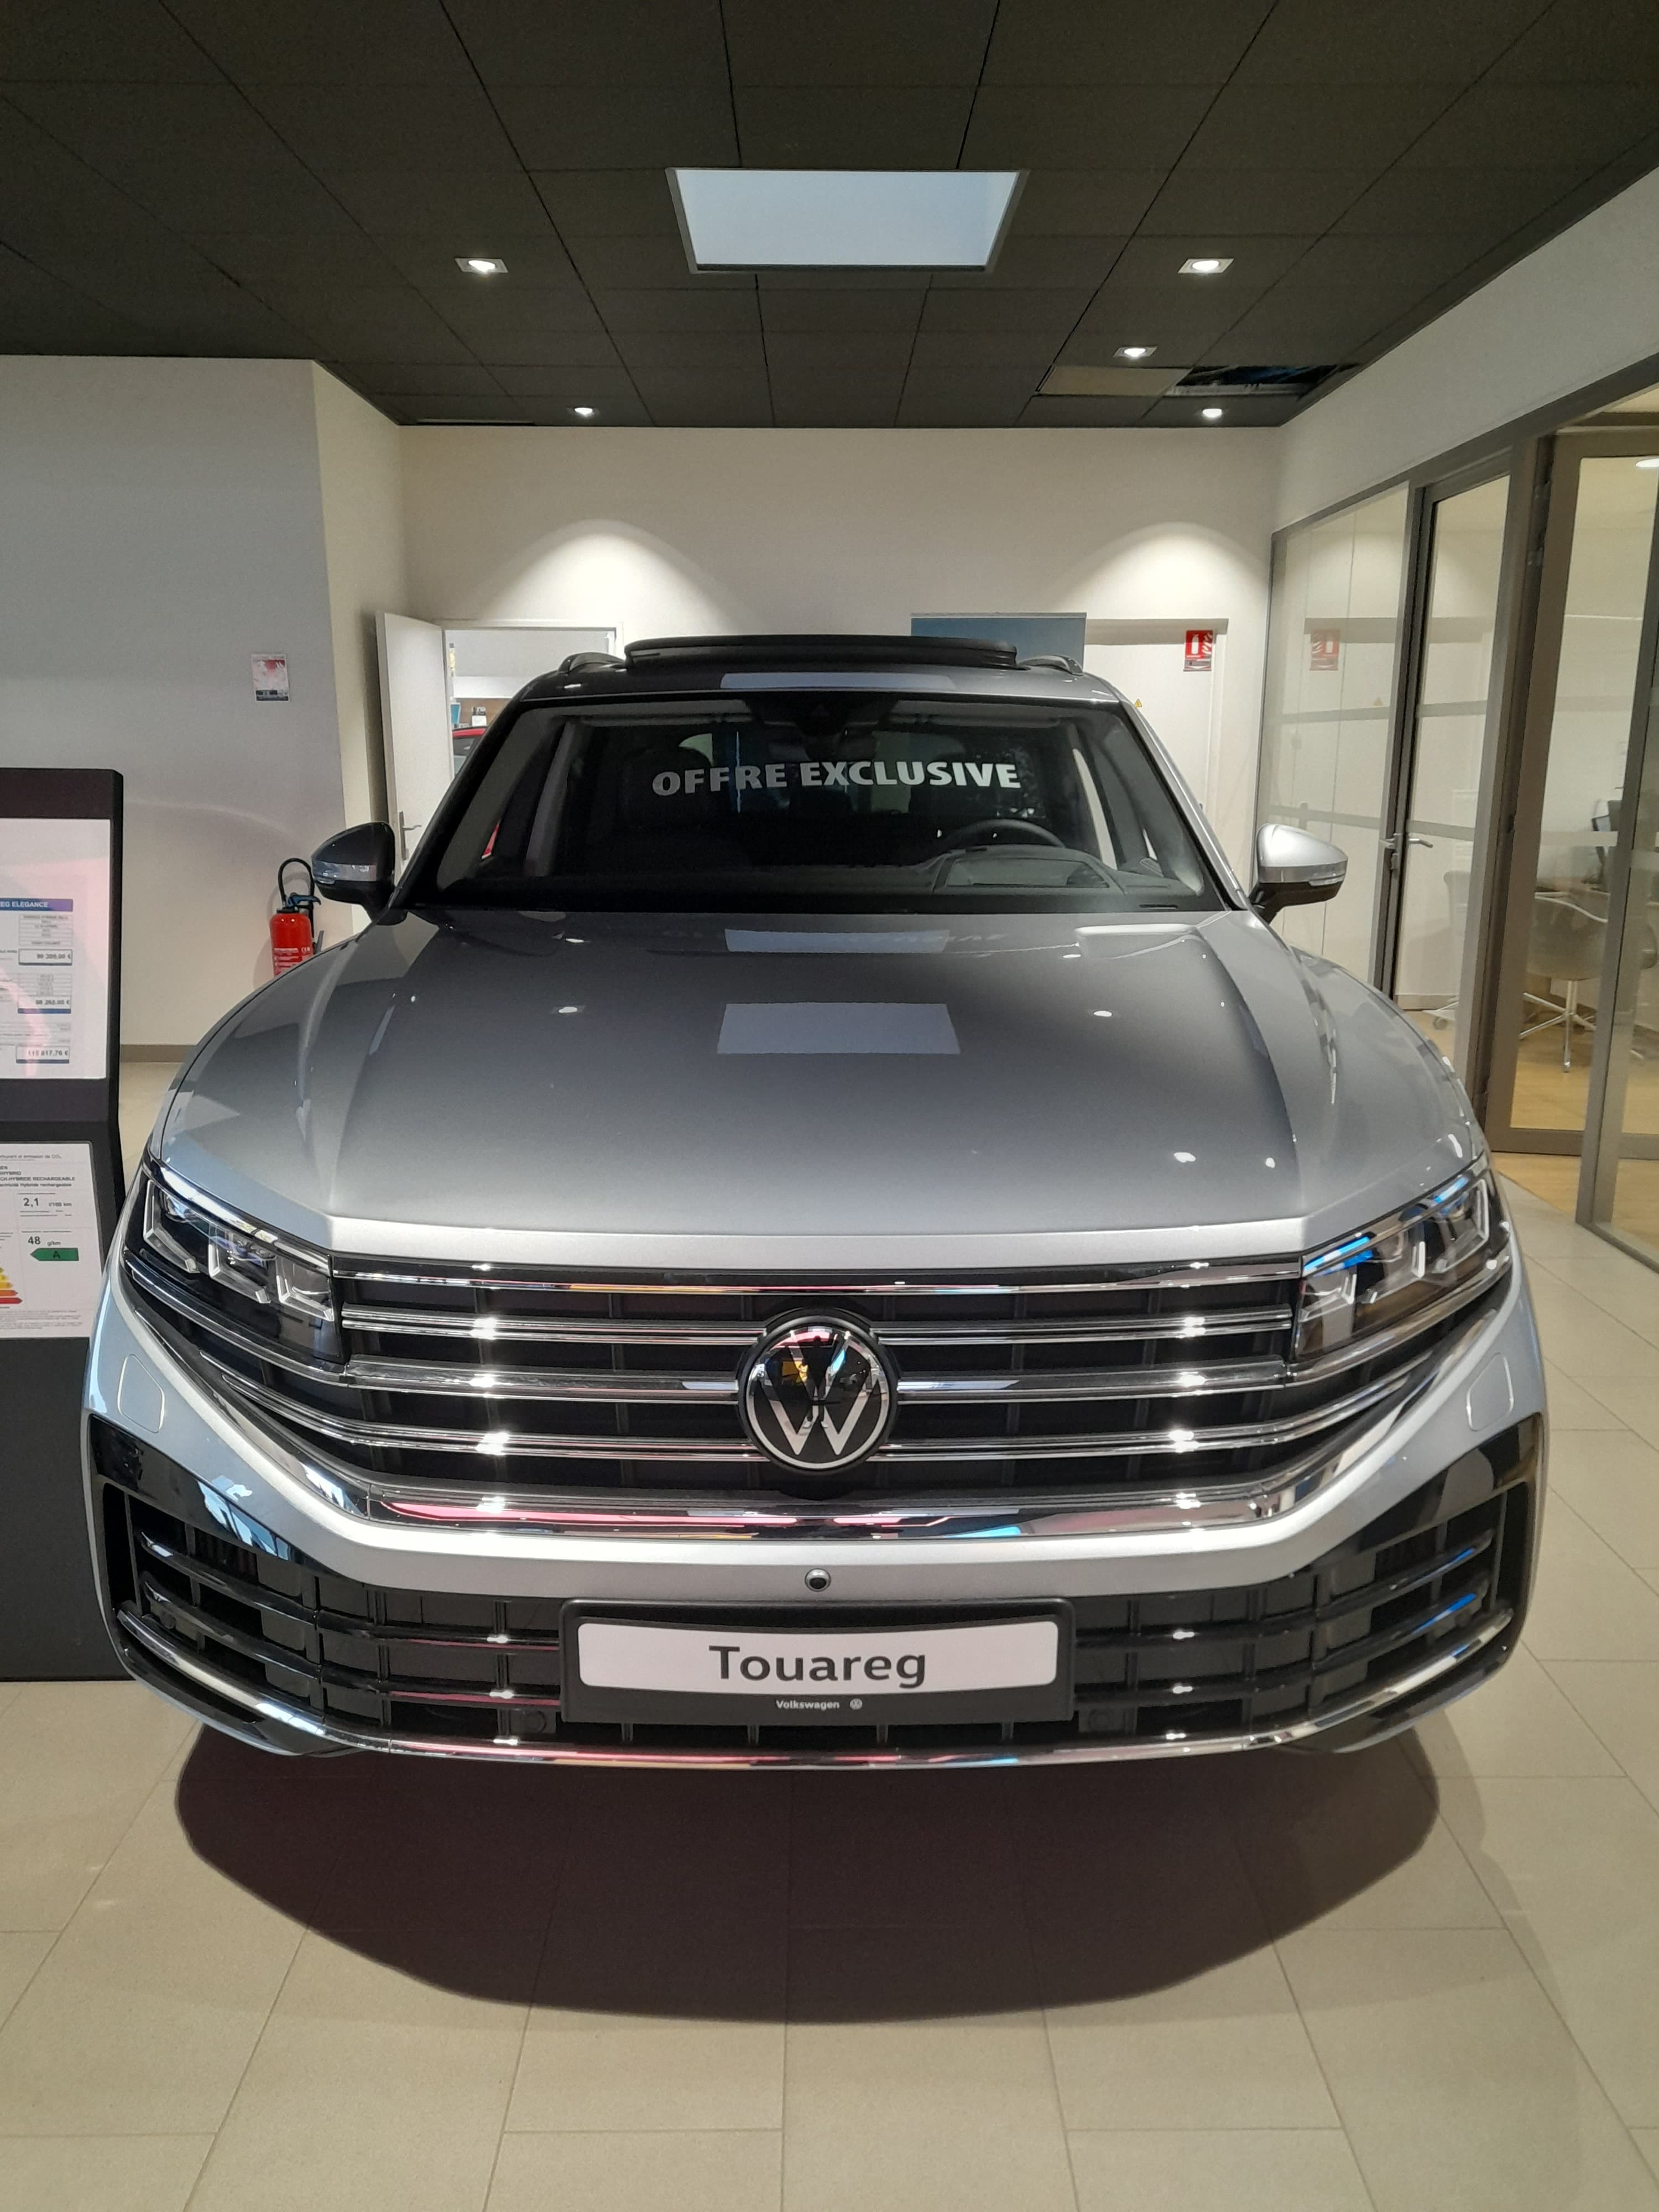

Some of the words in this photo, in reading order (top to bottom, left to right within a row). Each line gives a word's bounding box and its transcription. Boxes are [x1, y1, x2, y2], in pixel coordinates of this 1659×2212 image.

[652, 763, 787, 796] OFFRE
[800, 760, 1021, 789] EXCLUSIVE
[23, 1197, 39, 1207] 2,1
[28, 1235, 41, 1245] 48
[53, 1250, 61, 1259] A
[708, 1645, 926, 1689] Touareg
[775, 1699, 840, 1711] Volkswagen
